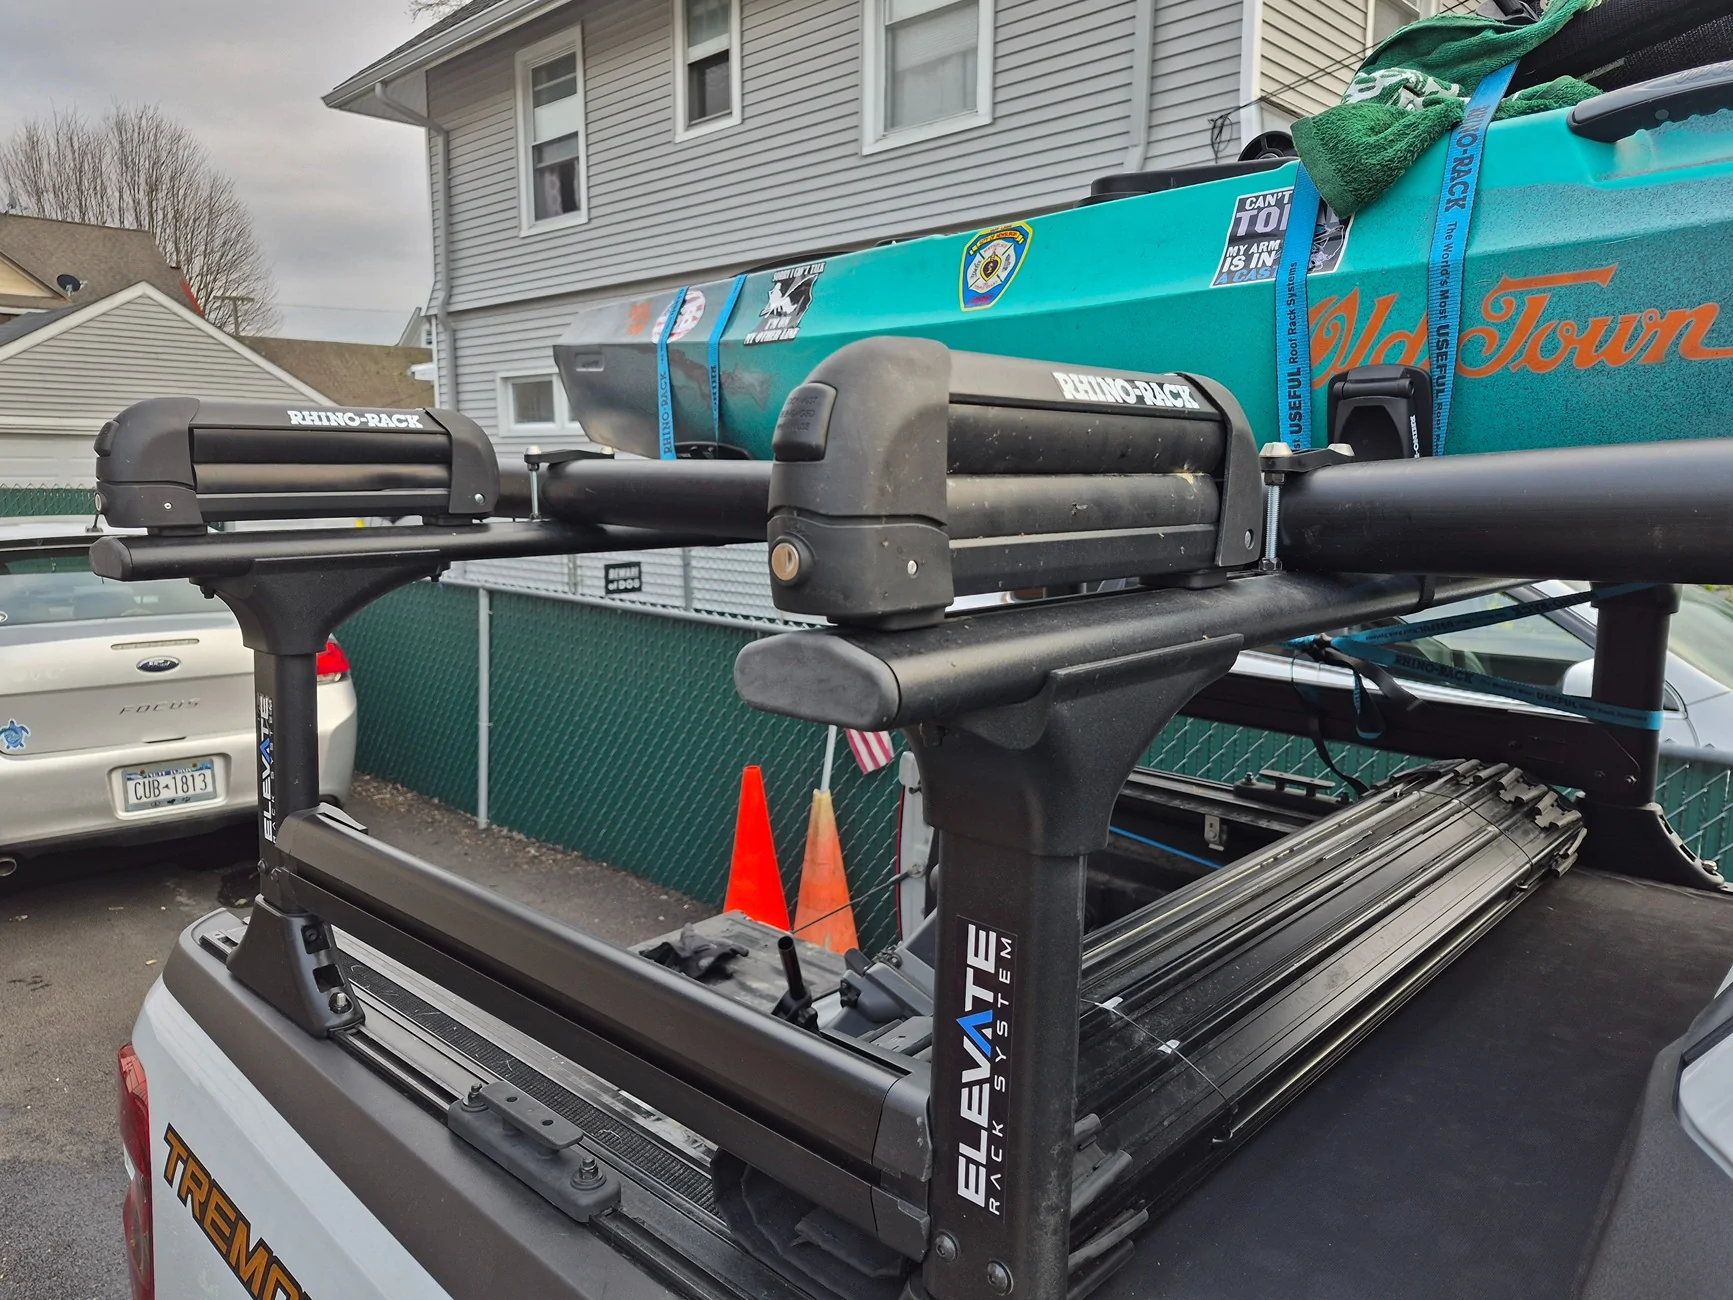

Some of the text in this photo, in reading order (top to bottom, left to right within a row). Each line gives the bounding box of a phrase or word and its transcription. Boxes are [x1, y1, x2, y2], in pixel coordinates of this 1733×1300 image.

[1245, 190, 1294, 211] CAN'T
[1226, 239, 1280, 258] MY ARM
[1444, 221, 1457, 240] The
[1214, 272, 1228, 285] A
[1222, 250, 1277, 273] IS IN
[1439, 244, 1453, 286] World's
[1286, 261, 1298, 306] Systems
[1287, 308, 1297, 335] Rack
[1438, 290, 1449, 320] Most
[1456, 262, 1733, 378] Town
[1288, 336, 1298, 364] Roof
[1434, 323, 1450, 399] USEFUL
[1050, 371, 1200, 409] RHINO-RACK
[1287, 367, 1303, 435] USEFUL
[287, 410, 424, 429] RHINO-RACK
[660, 371, 673, 455] RHINO-RACK
[119, 697, 201, 716] FOCUS
[259, 695, 273, 843] ELEVATE
[956, 923, 997, 1208] ELEVATE
[988, 937, 1013, 1216] RACK SYSTEM
[163, 1122, 312, 1300] TREMO
